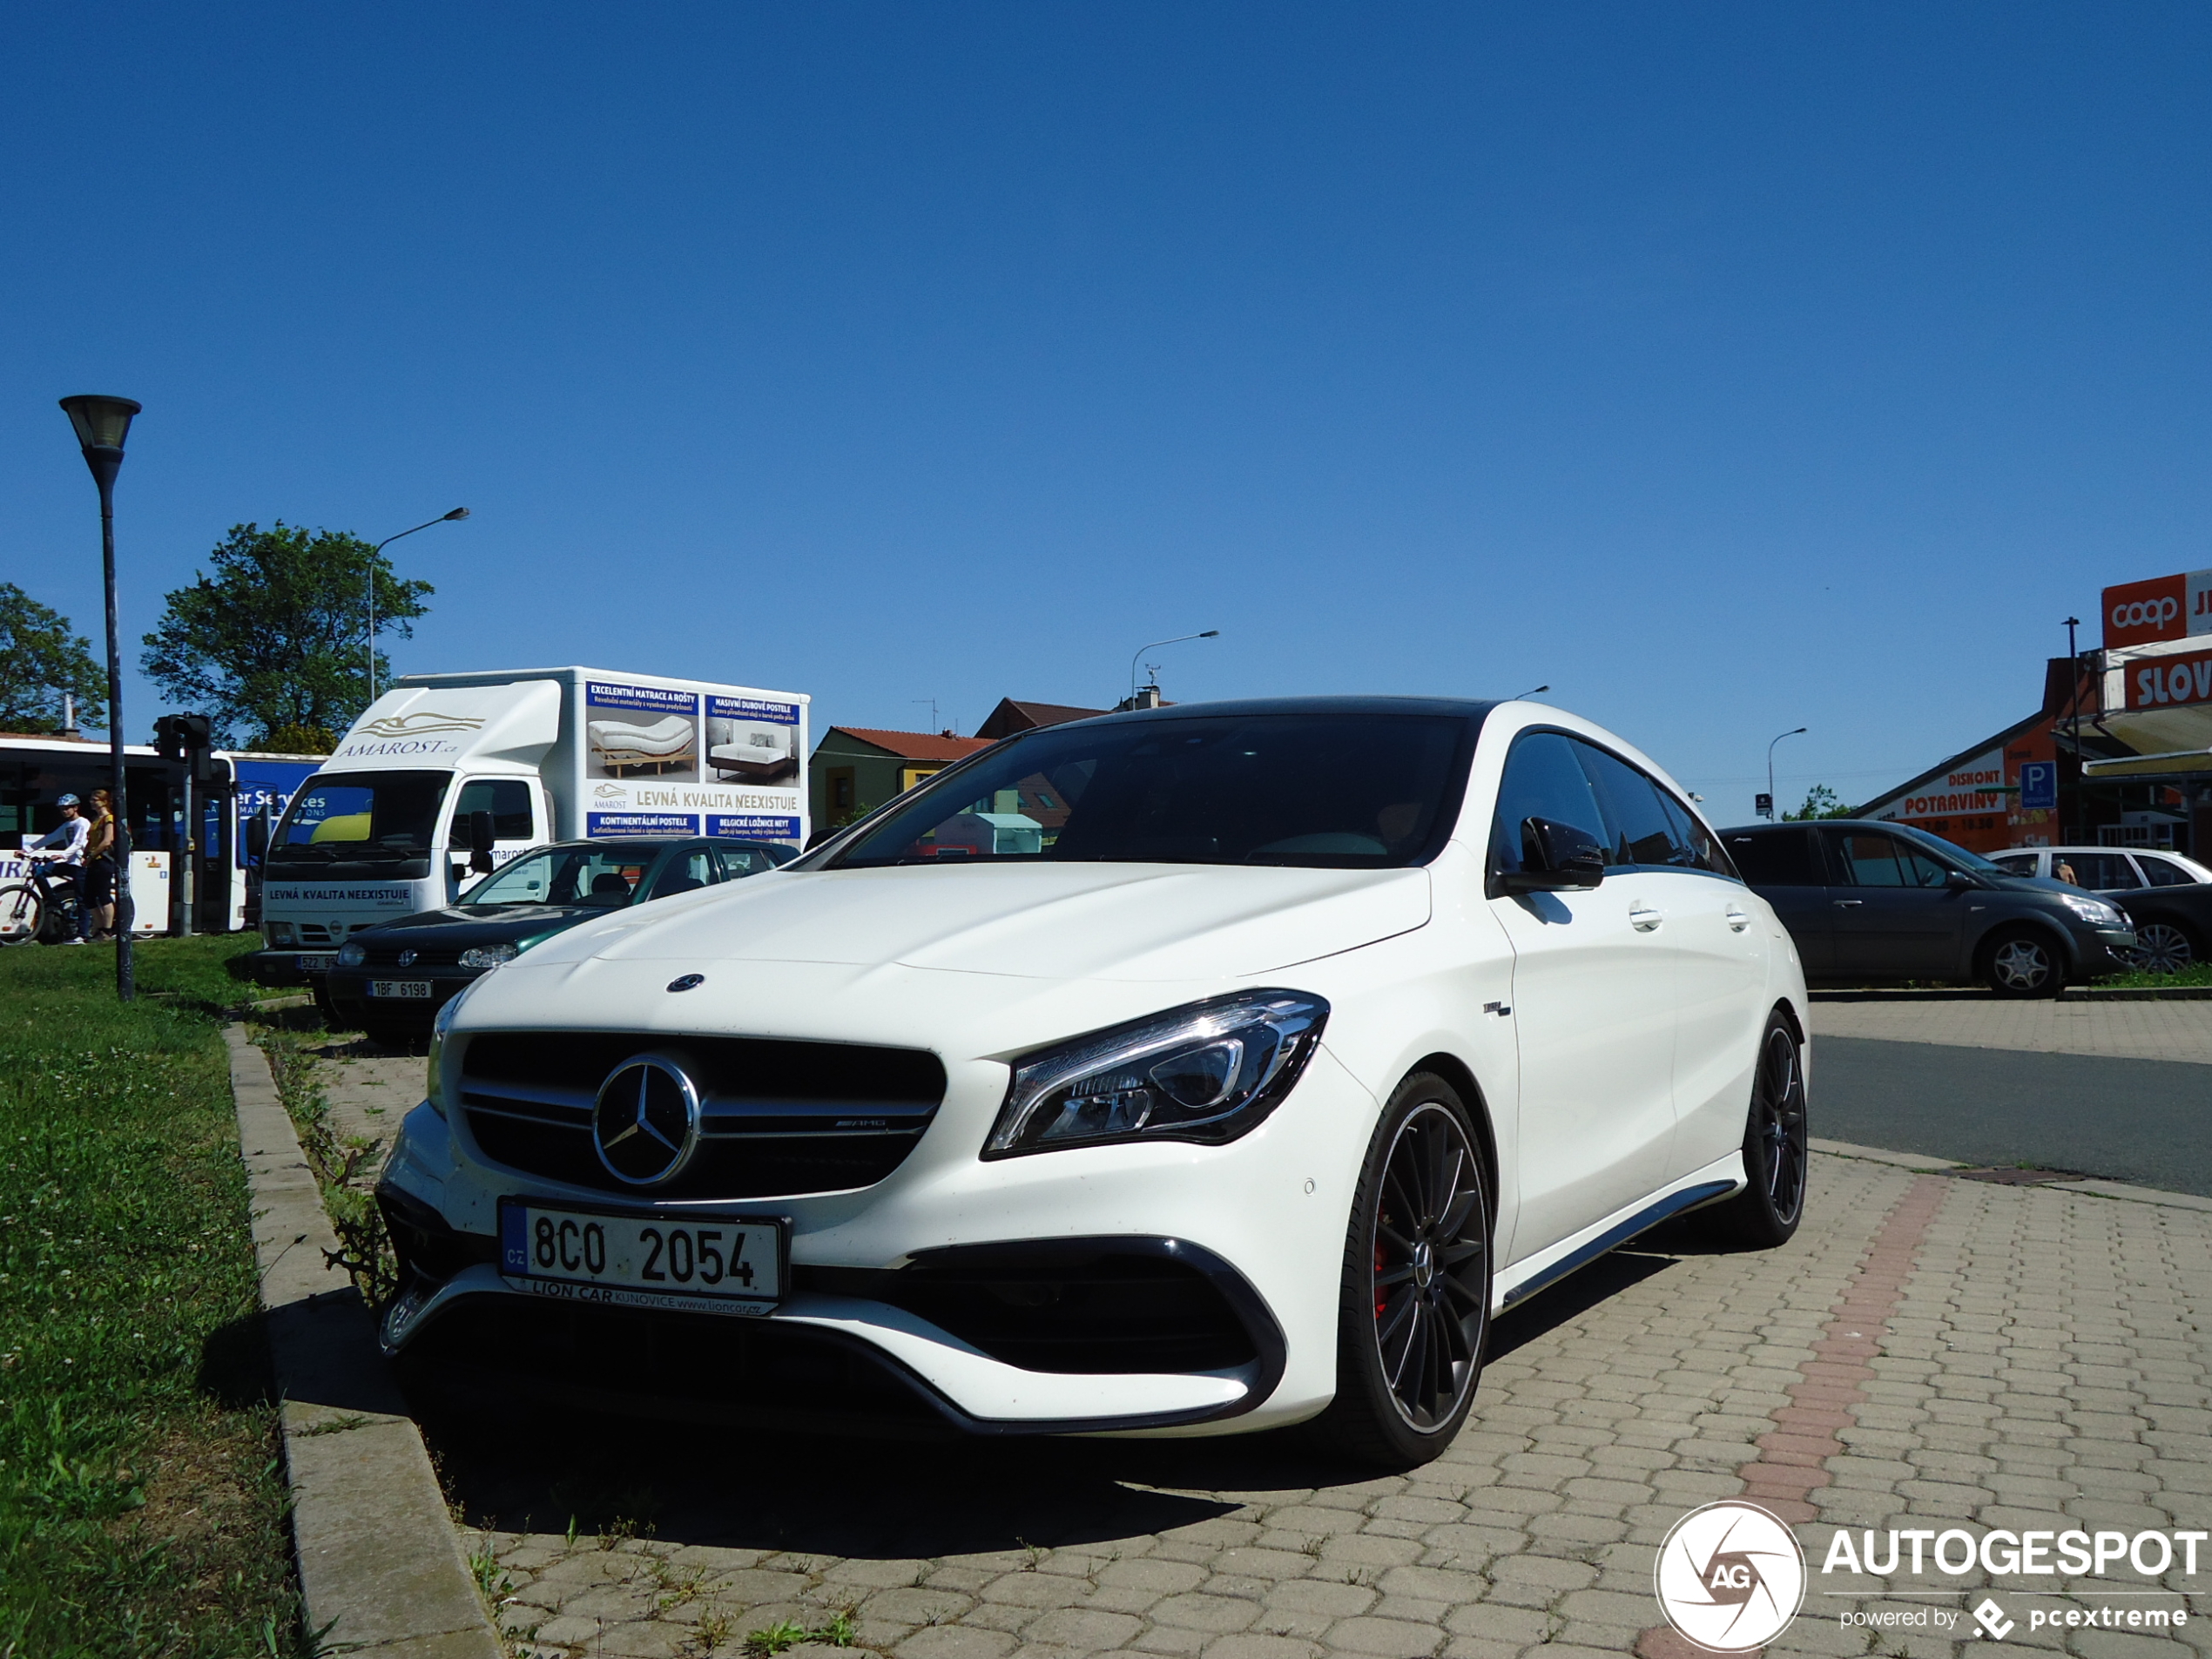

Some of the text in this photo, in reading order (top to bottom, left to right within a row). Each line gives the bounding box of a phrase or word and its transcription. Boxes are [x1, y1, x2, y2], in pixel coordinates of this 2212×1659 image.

[2111, 596, 2178, 631] coop
[2137, 660, 2212, 705] SLOV
[591, 685, 634, 698] EXCELENTNÍ
[635, 690, 667, 700] MATRACE
[673, 691, 696, 704] ROŠTY
[715, 698, 791, 713] MASIVNÍ DUBOVÉ POSTELE
[1949, 771, 2000, 787] DISKONT
[2028, 766, 2046, 791] P
[593, 800, 627, 809] AMAROST
[637, 787, 797, 811] LEVNÁ KVALITA NEEXISTUJE
[1905, 792, 1998, 815] POTRAVINY
[600, 815, 688, 826] KONTINENTÁLNÍ POSTELE
[719, 817, 748, 827] BELGICKÉ
[749, 817, 774, 827] LOŽNICE
[270, 887, 409, 900] LEVNÁ KVALITA NEEXISTUJE
[375, 982, 427, 996] 1BF 6198
[507, 1248, 524, 1264] CZ
[639, 1227, 754, 1288] 2054
[532, 1281, 574, 1297] LION
[578, 1286, 613, 1303] CAR
[615, 1291, 675, 1308] KUNOVICE
